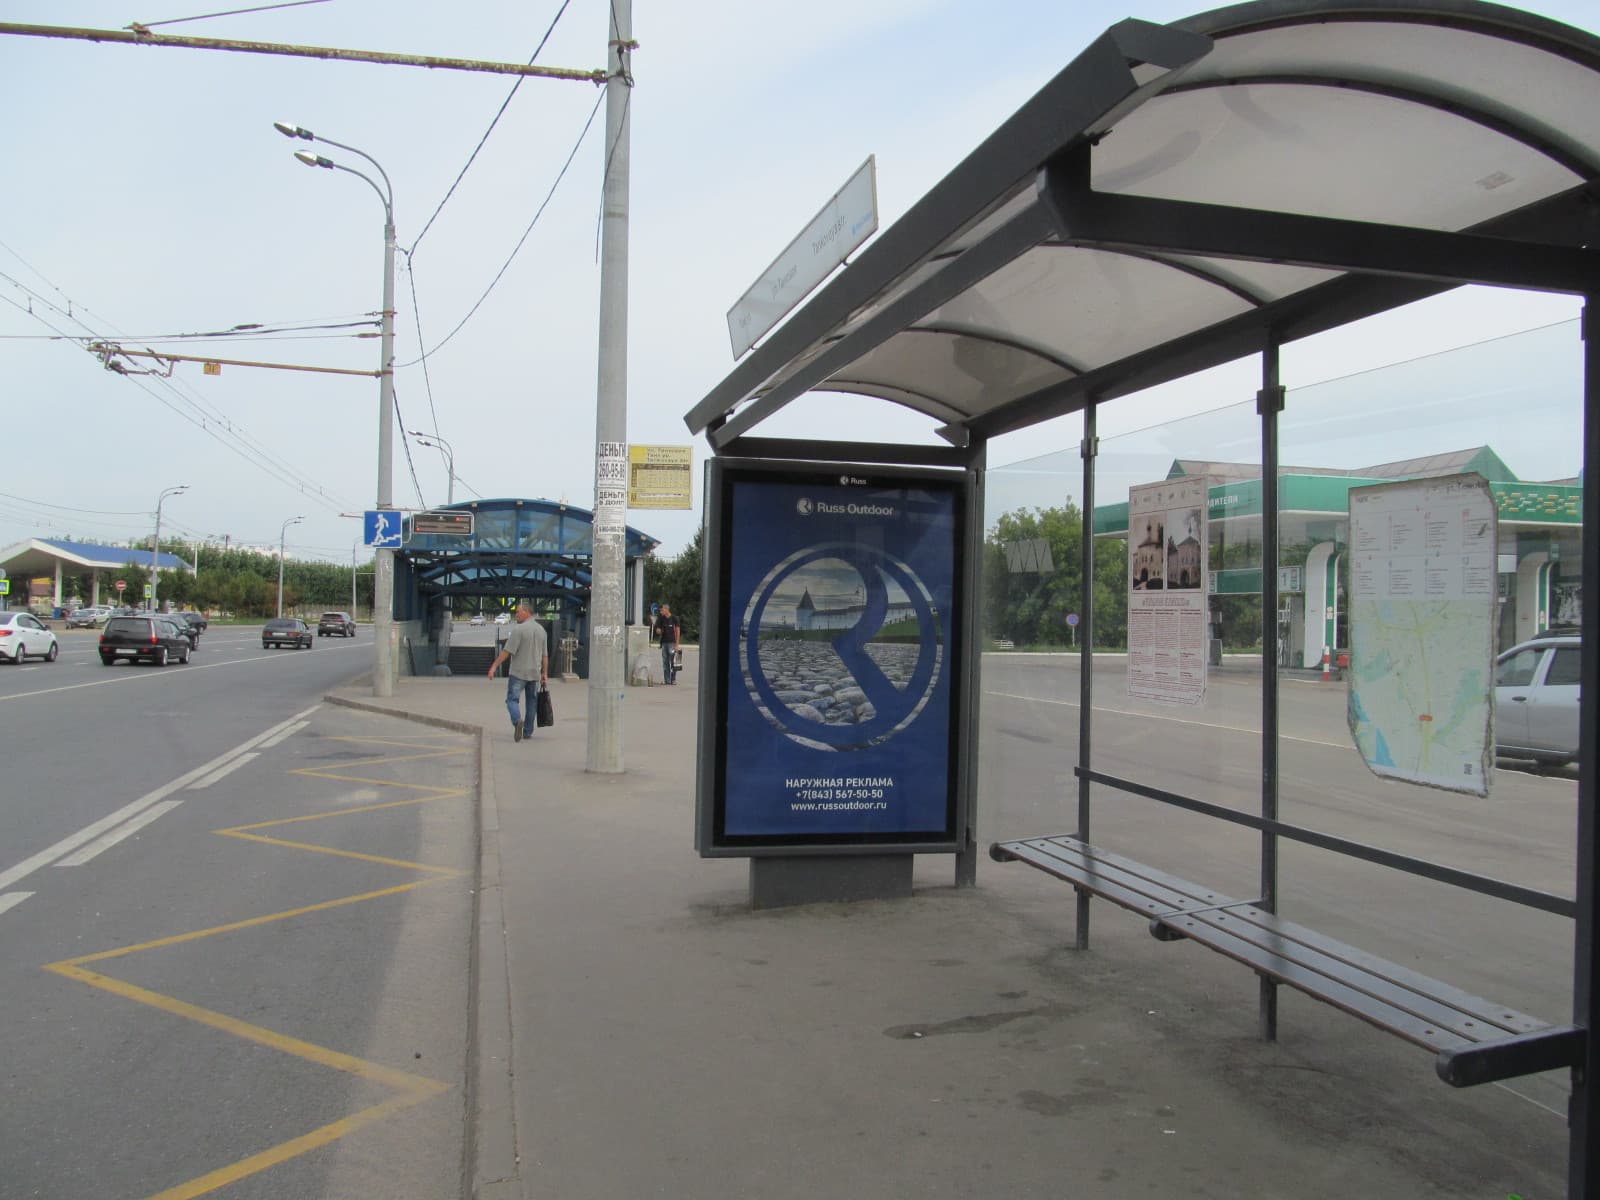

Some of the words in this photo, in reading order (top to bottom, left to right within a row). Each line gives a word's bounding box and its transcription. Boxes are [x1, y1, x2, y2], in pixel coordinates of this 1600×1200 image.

[851, 477, 867, 485] Russ
[817, 502, 845, 513] Russ
[847, 503, 893, 515] Outdoor
[786, 778, 843, 788] НАРУЖНАЯ
[846, 777, 893, 787] РЕКЛАМА
[796, 789, 833, 800] +7(843)
[835, 789, 883, 799] 567-50-50
[791, 800, 887, 811] www.russoutdoor.ru
